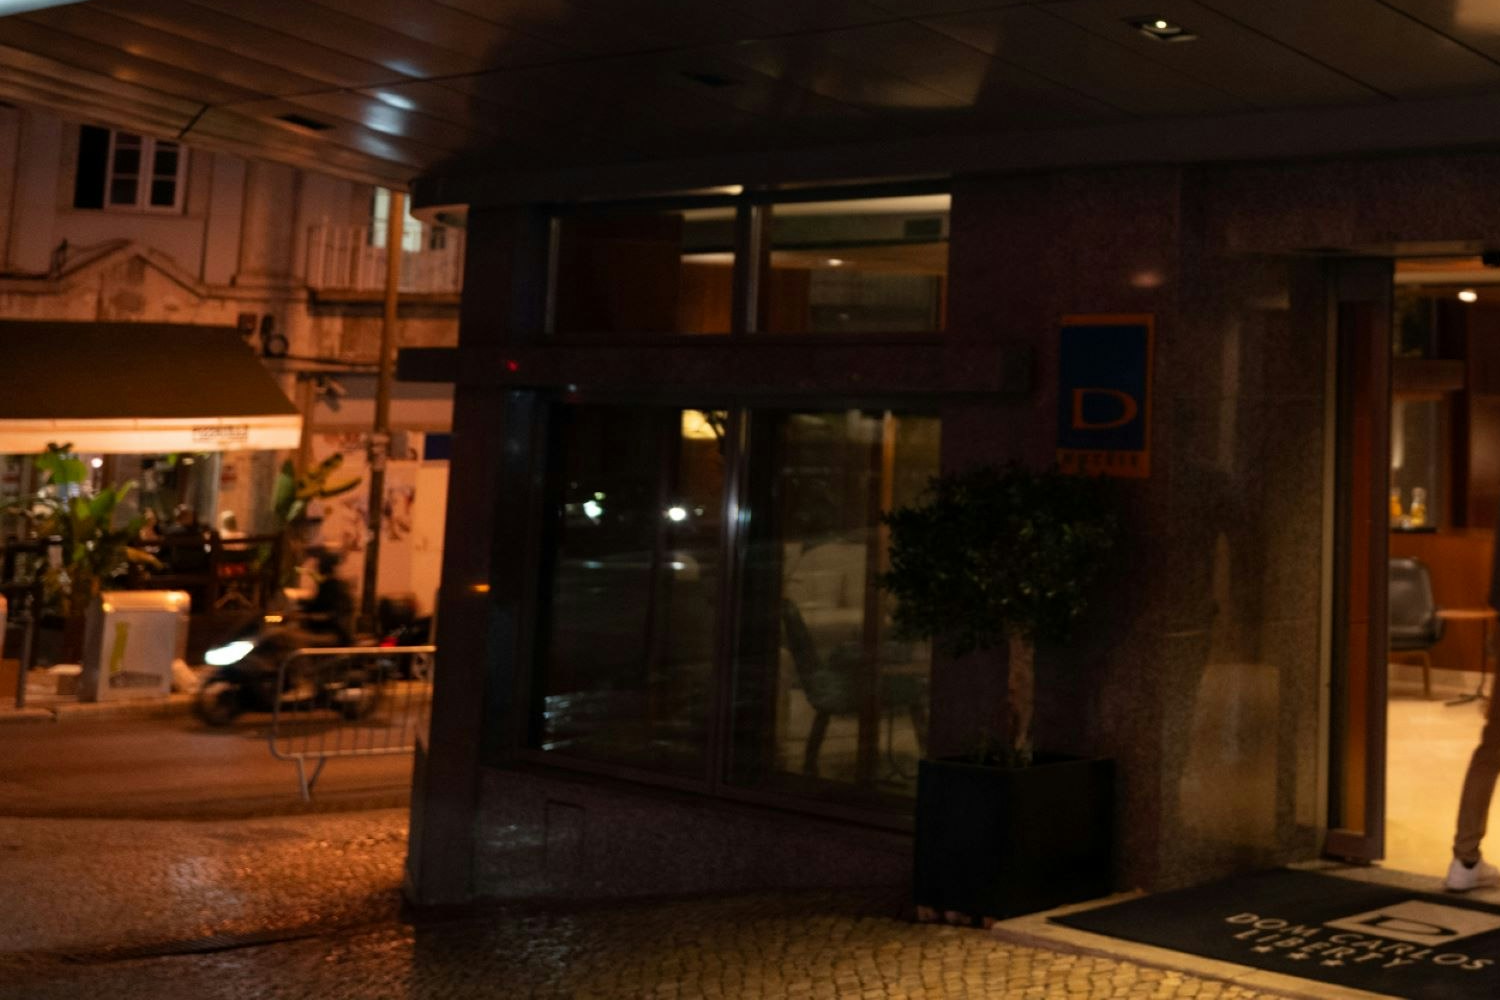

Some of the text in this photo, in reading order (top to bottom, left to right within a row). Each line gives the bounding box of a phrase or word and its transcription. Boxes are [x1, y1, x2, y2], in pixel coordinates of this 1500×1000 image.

[1072, 388, 1138, 429] D
[1225, 912, 1495, 971] DOM CARLOS
[1233, 928, 1414, 969] LIBERTY
